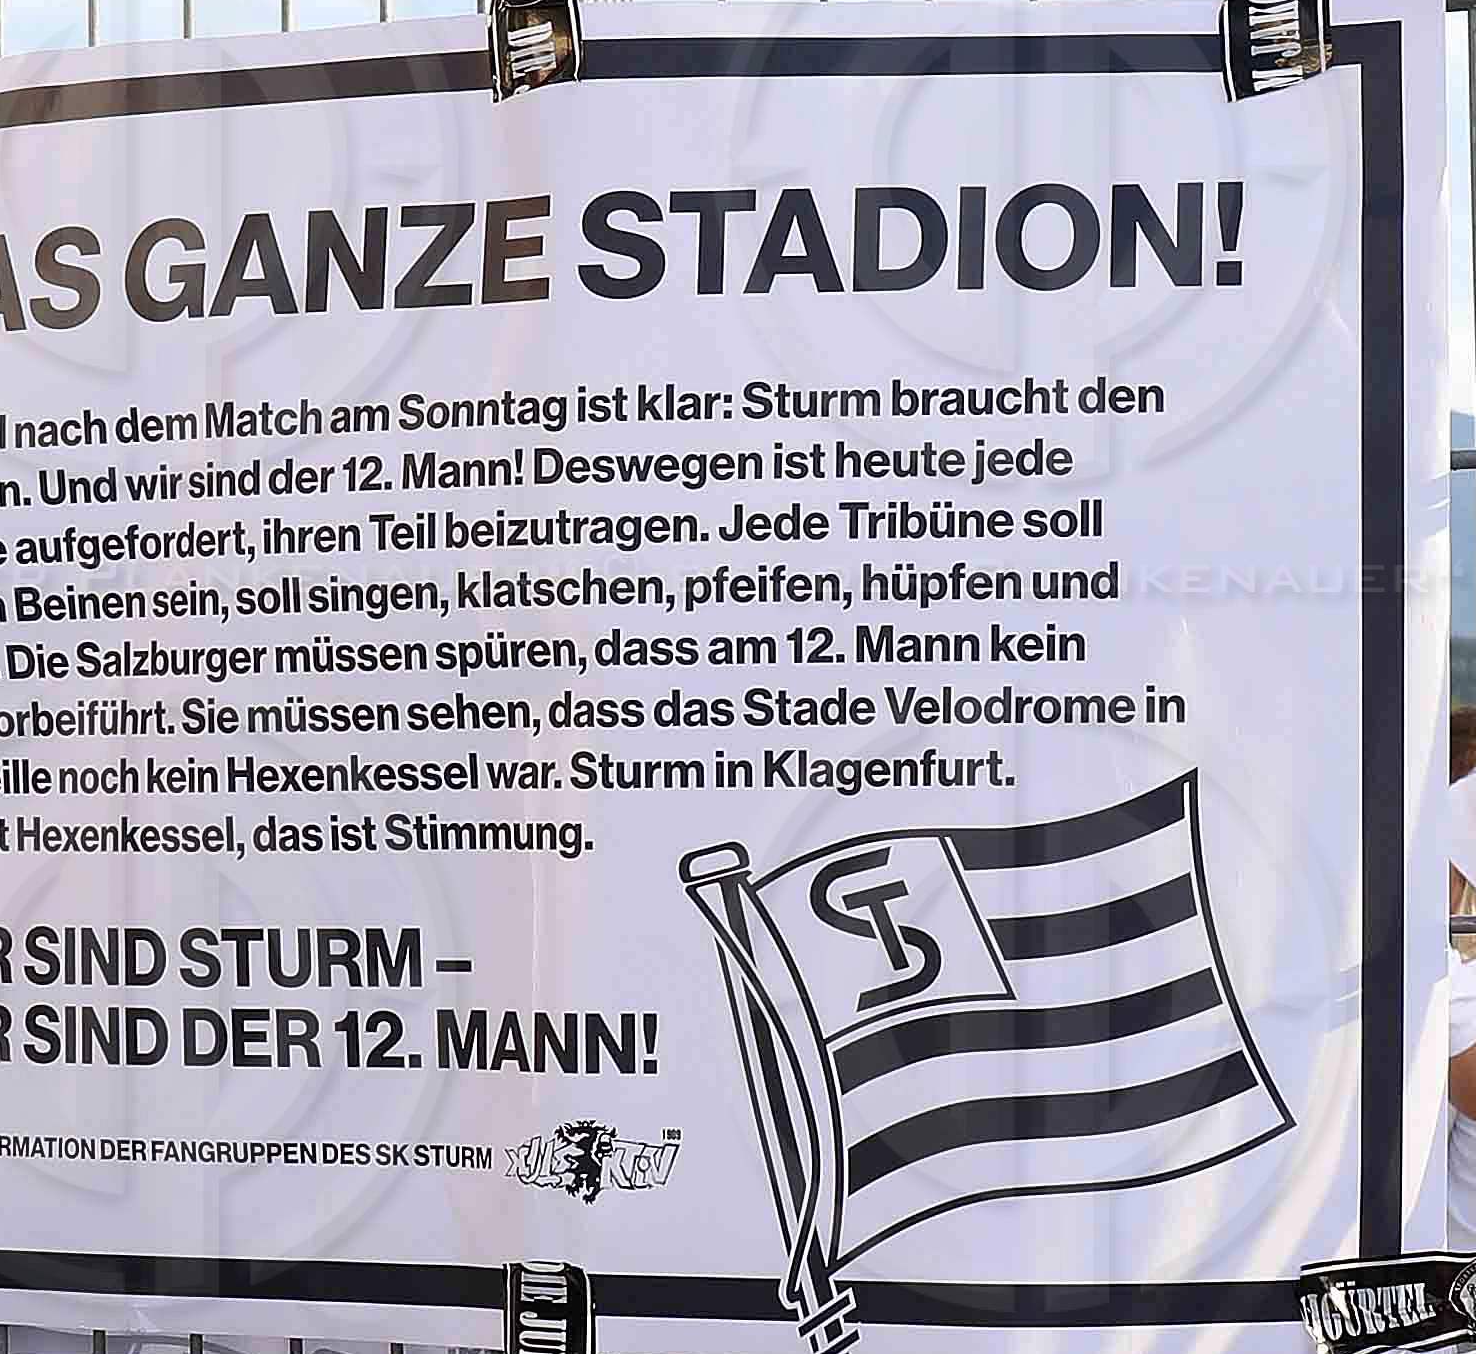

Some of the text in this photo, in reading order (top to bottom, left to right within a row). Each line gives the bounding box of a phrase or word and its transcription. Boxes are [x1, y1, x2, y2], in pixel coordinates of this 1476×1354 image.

[124, 194, 551, 323] GANZE
[577, 181, 1244, 300] STADION!
[15, 409, 108, 449] nach
[115, 406, 198, 444] dem
[205, 398, 322, 439] Match
[329, 404, 390, 434] am
[398, 390, 568, 433] Sonntag
[577, 385, 629, 423] ist
[637, 383, 733, 422] klar:
[741, 381, 881, 420] Sturm
[891, 377, 1069, 417] braucht
[1078, 376, 1165, 414] den
[38, 466, 118, 506] Und
[124, 464, 183, 502] wir
[188, 459, 261, 499] sind
[268, 458, 336, 496] der
[342, 455, 393, 492] 12.
[401, 448, 524, 490] Mann!
[533, 447, 763, 490] Deswegen
[773, 442, 826, 480] ist
[835, 440, 966, 479] heute
[971, 438, 1074, 485] jede
[15, 521, 256, 570] aufgefordert,
[263, 517, 361, 555] ihren
[368, 512, 437, 552] Teil
[445, 509, 710, 552] beizutragen.
[718, 502, 830, 542] Jede
[838, 501, 1015, 540] Tribüne
[1022, 498, 1103, 538] soll
[13, 584, 146, 622] Beinen
[152, 579, 229, 624] sein,
[235, 576, 302, 615] soll
[308, 575, 449, 620] singen,
[457, 567, 675, 613] klatschen,
[685, 564, 853, 612] pfeifen,
[862, 562, 1022, 609] hüpfen
[1032, 560, 1119, 600] und
[5, 643, 70, 680] Die
[76, 640, 268, 683] Salzburger
[275, 635, 428, 673] müssen
[435, 631, 587, 678] spüren,
[594, 628, 699, 667] dass
[707, 636, 777, 665] am
[786, 626, 845, 664] 12.
[856, 624, 980, 663] Mann
[990, 623, 1086, 662] kein
[181, 697, 240, 735] Sie
[247, 696, 400, 733] müssen
[406, 692, 541, 737] sehen,
[548, 690, 645, 729] dass
[653, 689, 735, 728] das
[742, 686, 877, 727] Stade
[883, 685, 1136, 725] Velodrome
[1146, 685, 1185, 724] in
[59, 757, 139, 795] noch
[147, 756, 219, 794] kein
[226, 752, 479, 793] Hexenkessel
[485, 761, 562, 790] war.
[569, 750, 705, 790] Sturm
[715, 750, 753, 788] in
[763, 748, 1015, 796] Klagenfurt.
[16, 815, 245, 861] Hexenkessel,
[252, 815, 324, 853] das
[330, 814, 378, 852] ist
[384, 813, 594, 859] Stimmung.
[23, 925, 167, 987] SIND
[179, 927, 423, 989] STURM
[23, 1004, 169, 1066] SIND
[182, 1007, 322, 1068] DER
[334, 1010, 422, 1069] 12.
[436, 1008, 658, 1075] MANN!
[99, 1138, 147, 1162] DER
[151, 1140, 317, 1165] FANGRUPPEN
[322, 1142, 371, 1166] DES
[375, 1143, 410, 1167] SK
[413, 1144, 493, 1170] STURM
